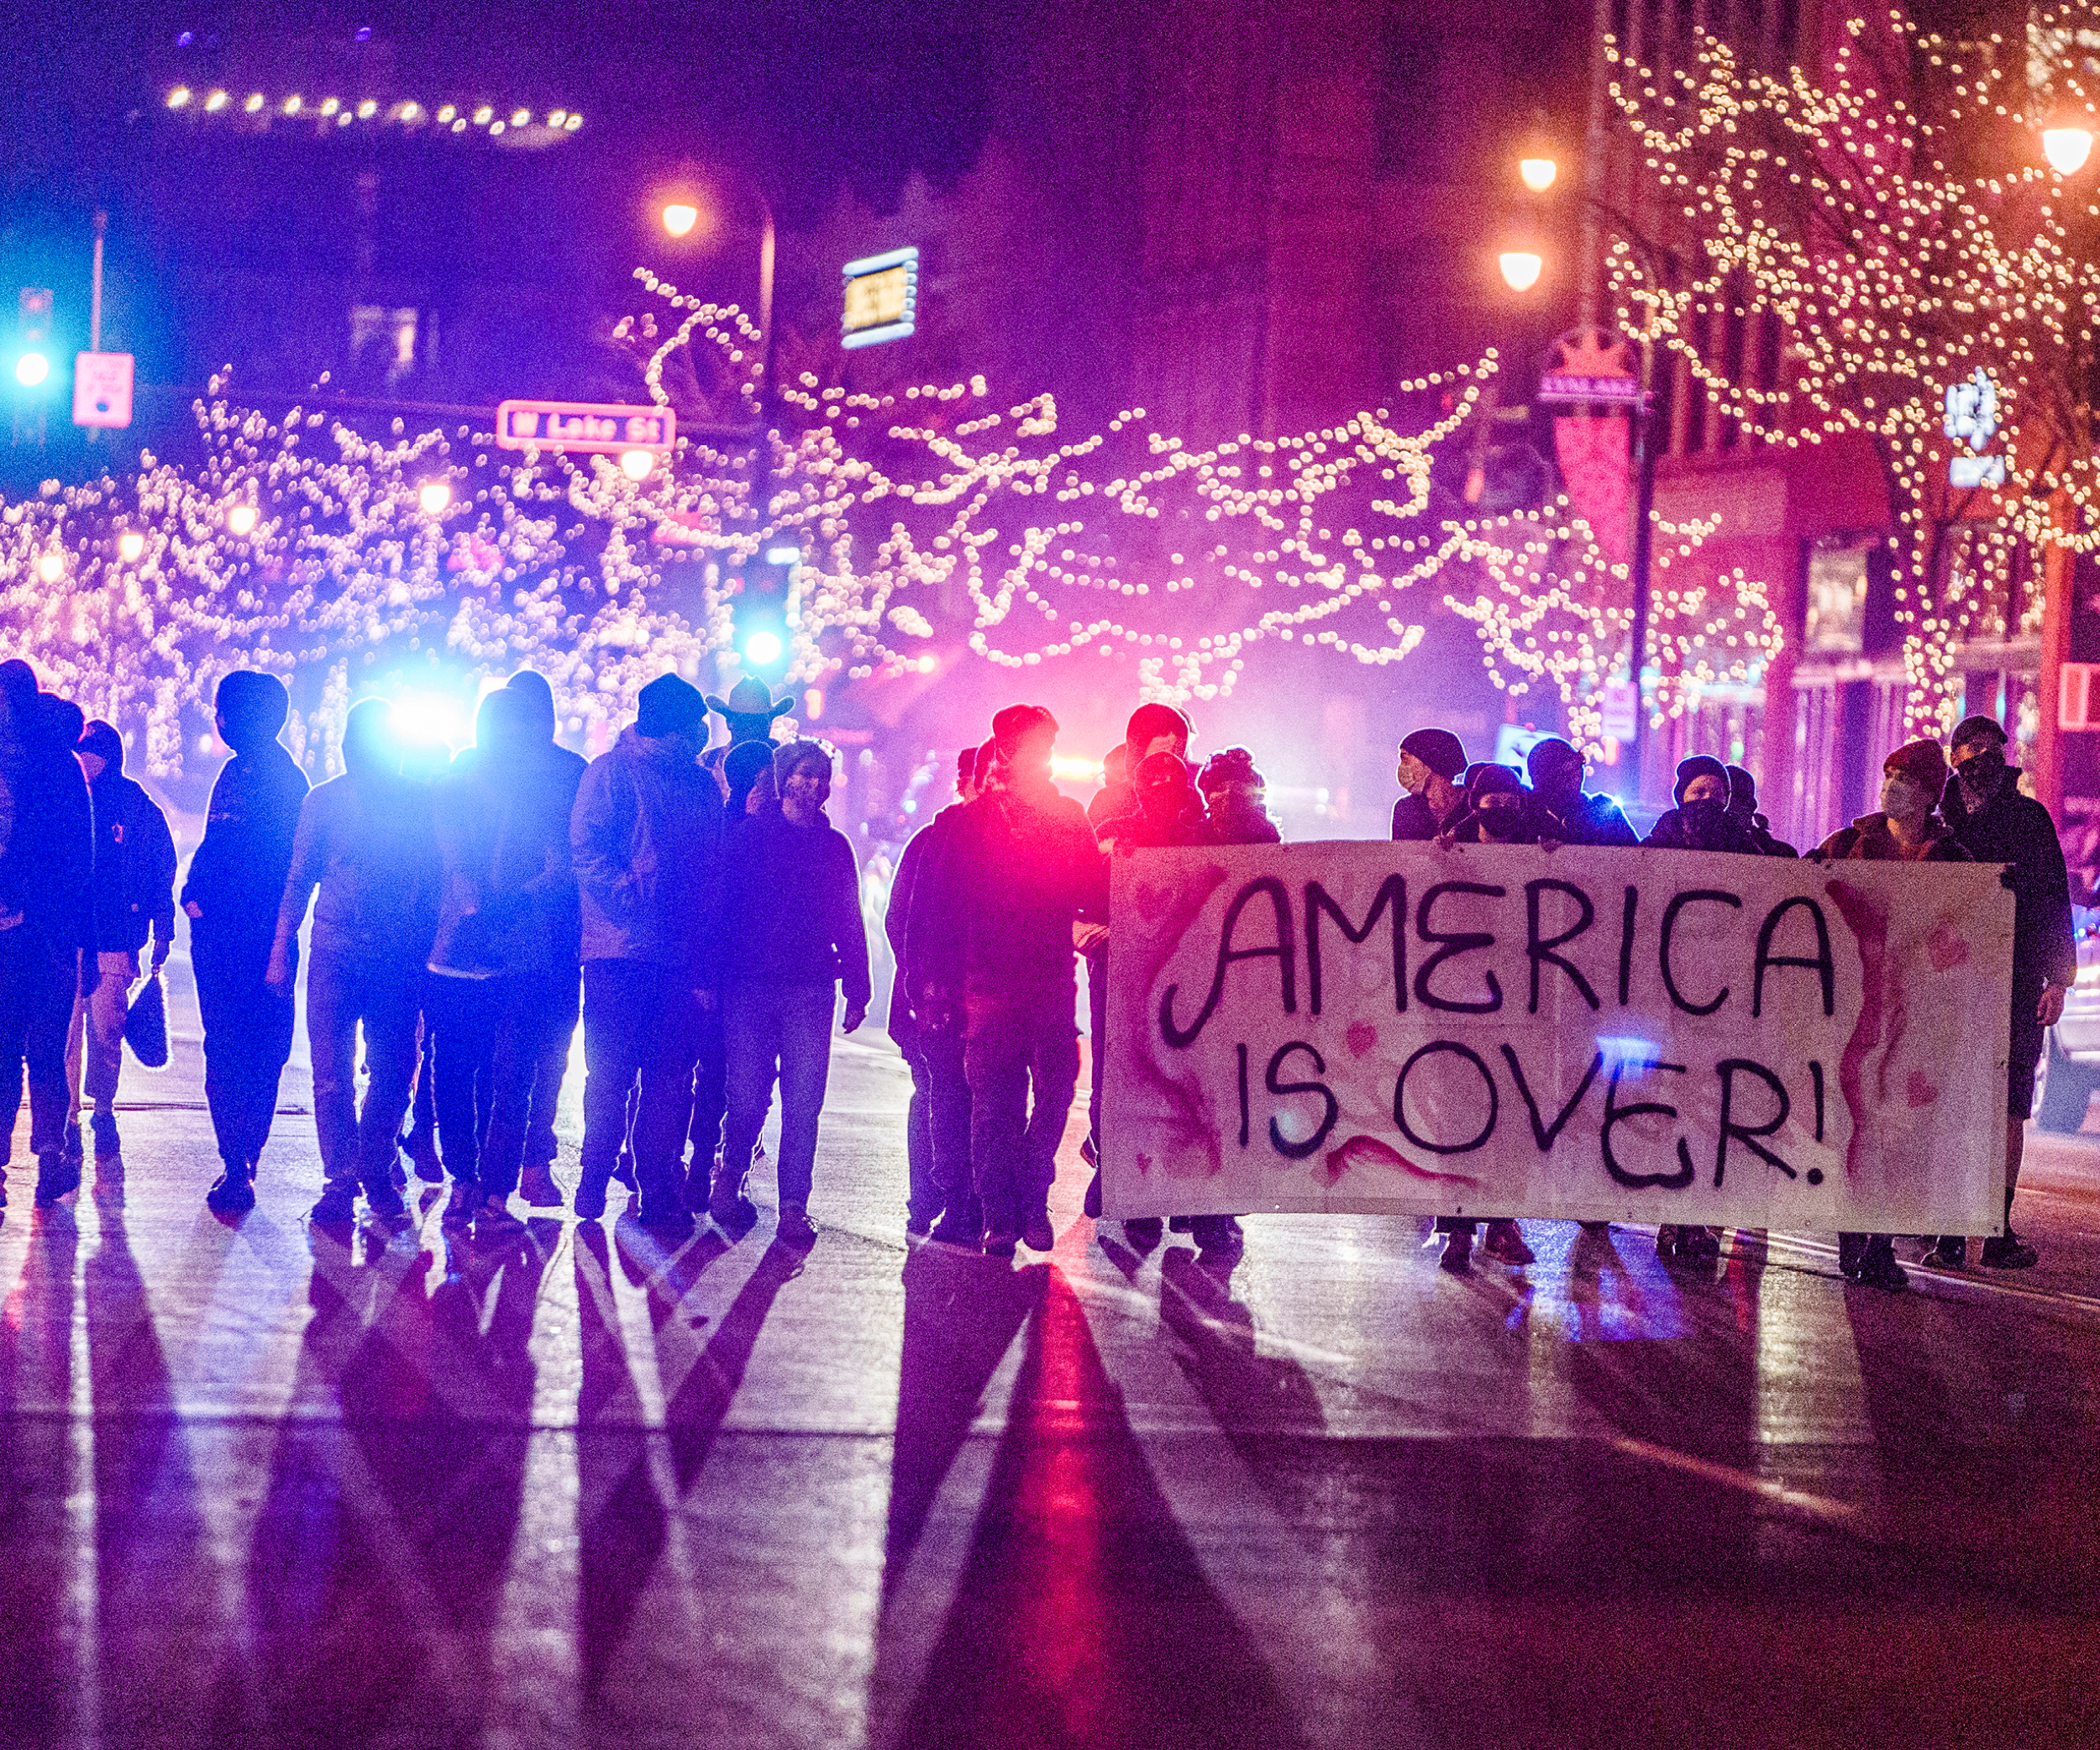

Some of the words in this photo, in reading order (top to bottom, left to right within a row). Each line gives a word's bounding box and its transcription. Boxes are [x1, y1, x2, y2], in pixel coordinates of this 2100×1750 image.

[512, 411, 539, 437] W
[547, 413, 617, 441] Lake
[625, 417, 660, 443] St
[1159, 874, 1835, 1048] AMERICA
[1238, 1040, 1340, 1159] IS
[1393, 1039, 1826, 1187] OVER!
